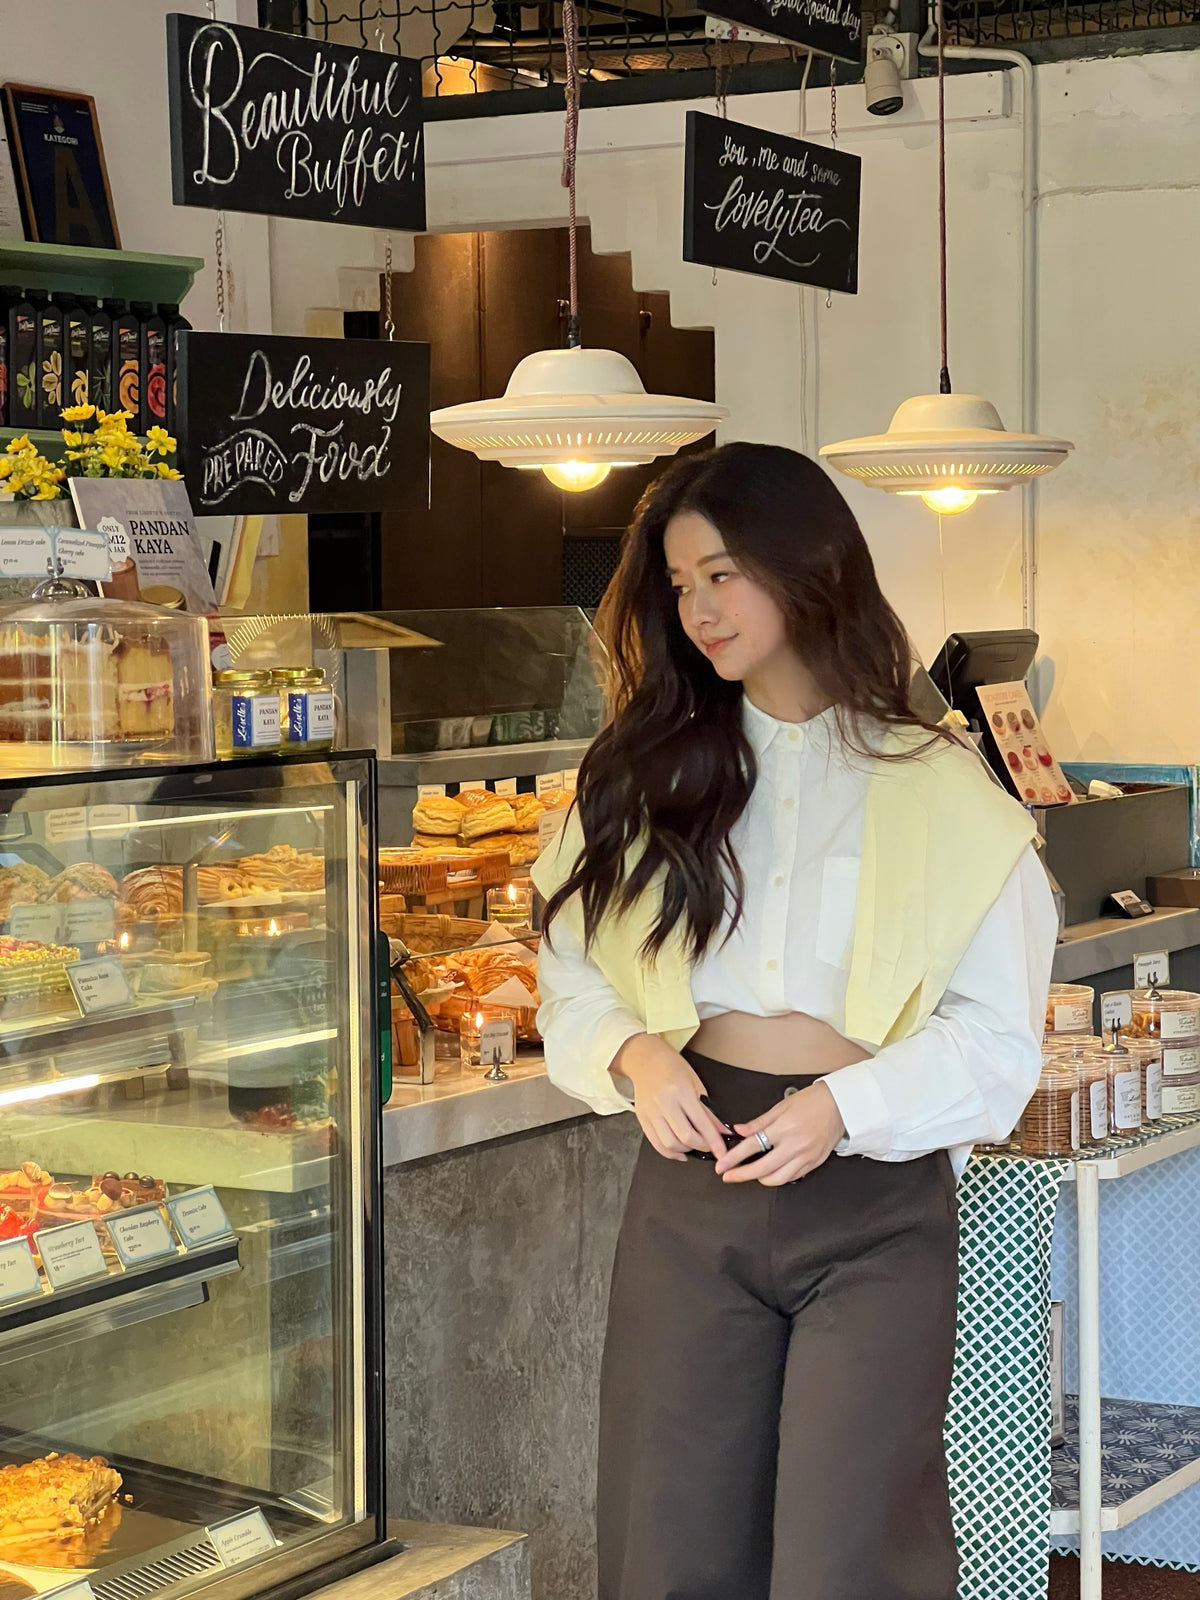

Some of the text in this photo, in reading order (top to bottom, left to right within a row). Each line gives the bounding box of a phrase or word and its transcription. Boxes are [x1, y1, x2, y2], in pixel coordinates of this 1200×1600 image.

[842, 3, 861, 40] day
[43, 133, 79, 146] KATEGORI
[277, 127, 420, 208] Buffet!
[782, 151, 808, 178] and
[810, 164, 841, 186] some
[230, 350, 402, 422] Deliciously
[203, 420, 392, 503] PREPARED Food
[102, 525, 120, 533] ONLY
[108, 534, 126, 545] M12
[129, 520, 190, 536] PANDAN
[134, 539, 174, 554] KAYA
